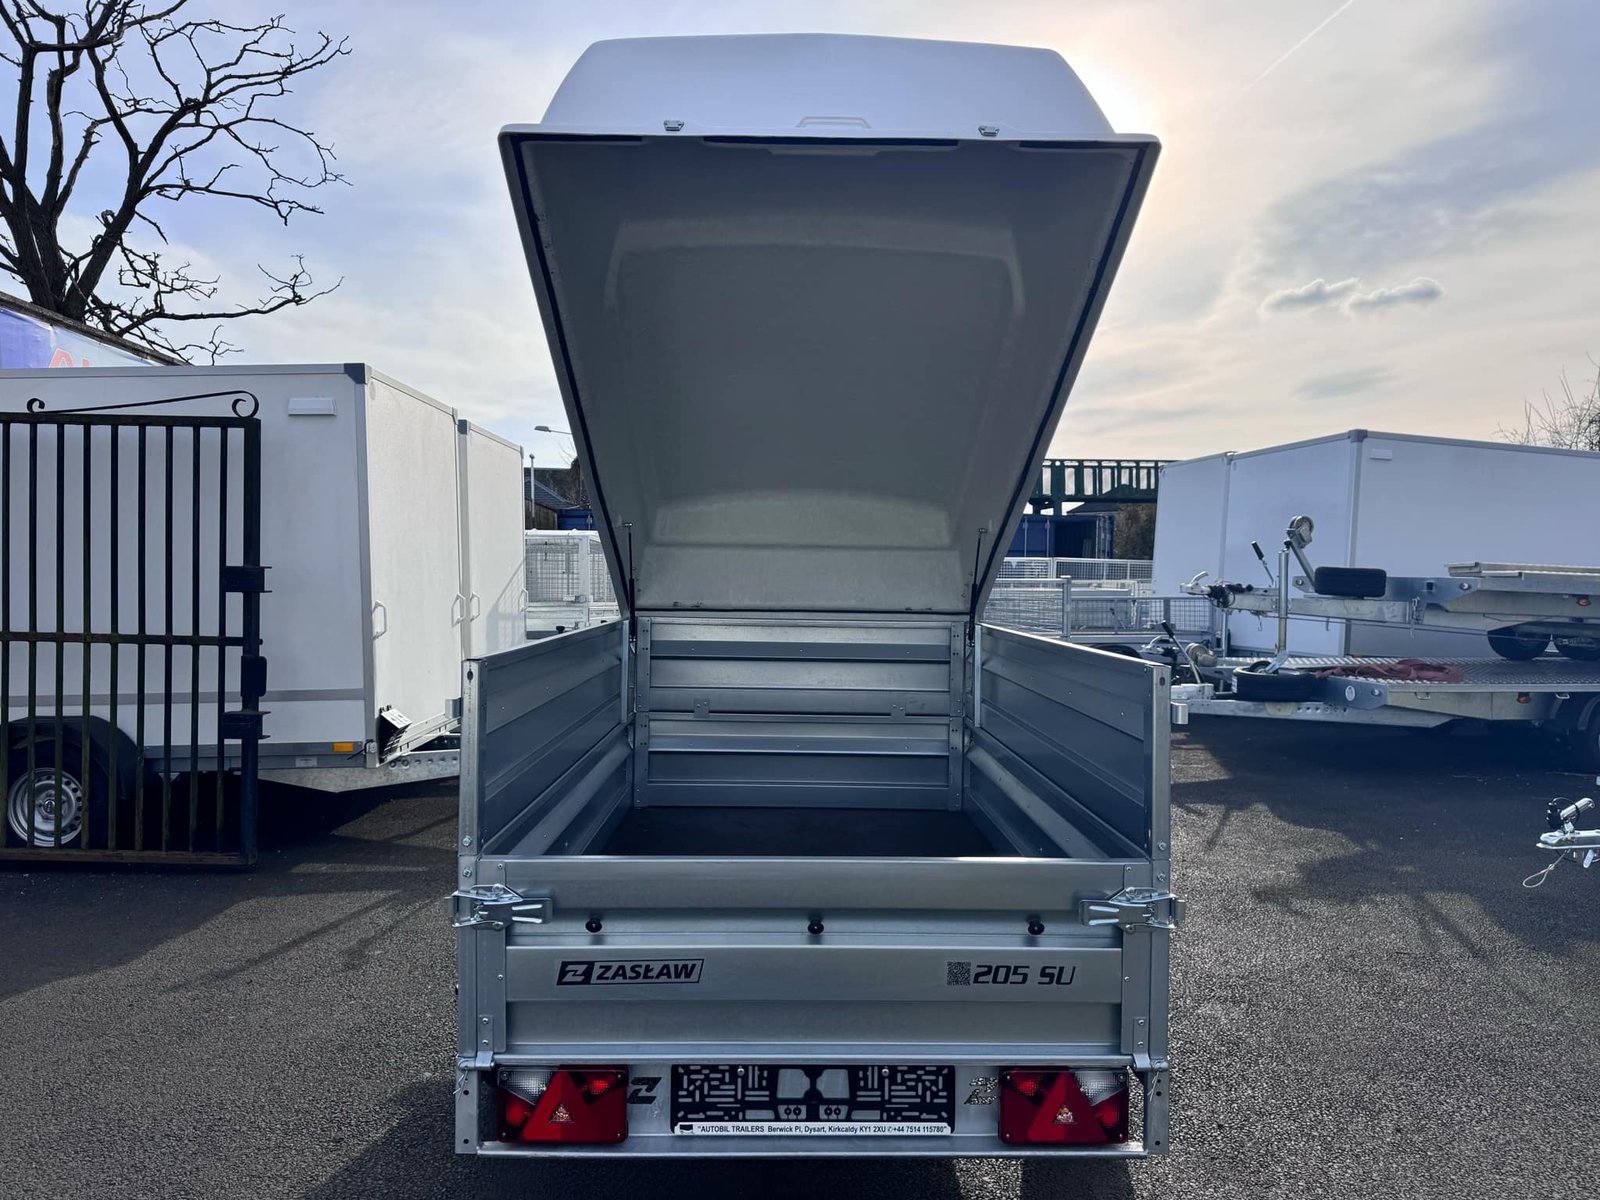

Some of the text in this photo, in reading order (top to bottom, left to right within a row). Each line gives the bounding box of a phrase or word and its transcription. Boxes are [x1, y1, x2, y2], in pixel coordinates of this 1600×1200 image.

[597, 964, 696, 980] ZASŁAW
[973, 965, 1076, 985] 205 SU
[732, 1125, 765, 1133] TRAILERS
[768, 1125, 793, 1133] Berwick
[804, 1125, 827, 1135] Dysart,
[828, 1125, 858, 1135] Kirkcaldy
[859, 1125, 871, 1133] KY1
[873, 1125, 885, 1133] 2XU
[906, 1125, 921, 1133] 7514
